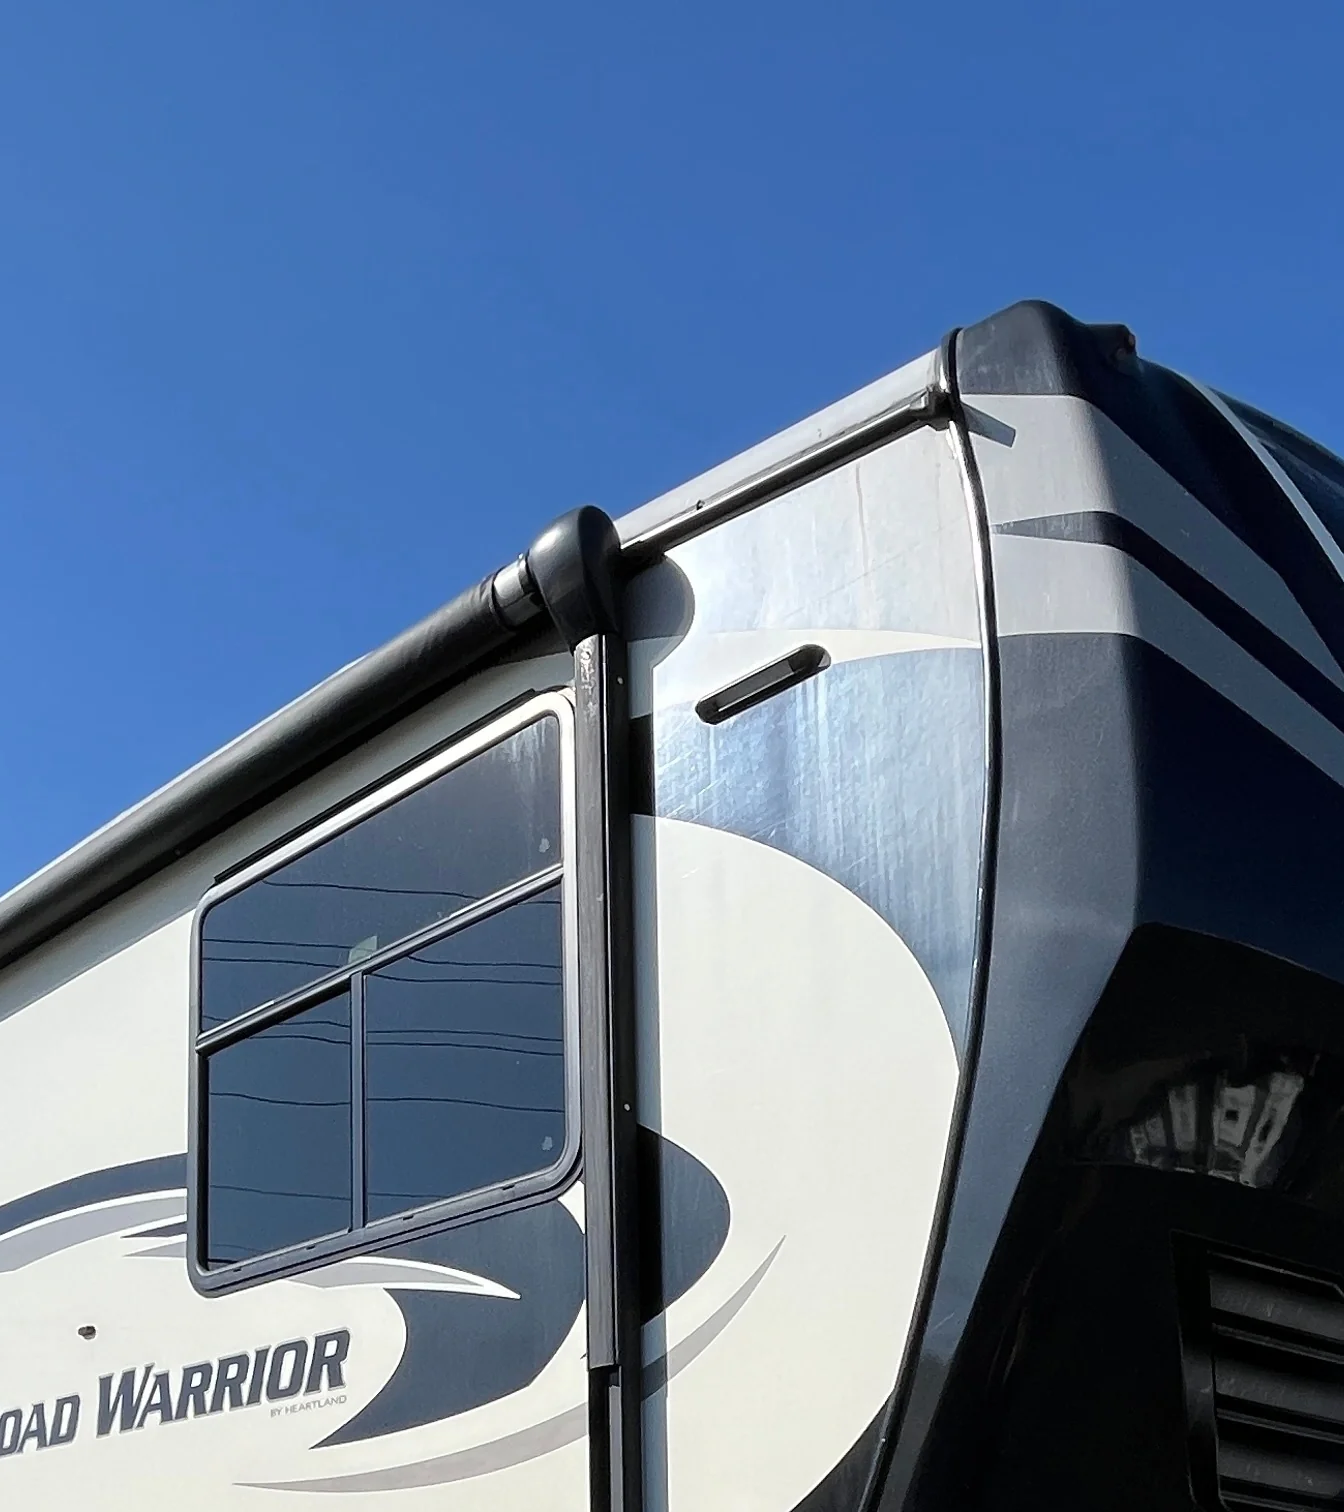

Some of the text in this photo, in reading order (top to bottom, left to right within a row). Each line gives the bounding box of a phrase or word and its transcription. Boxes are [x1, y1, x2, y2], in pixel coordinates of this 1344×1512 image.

[96, 1326, 351, 1440] WARRIOR
[270, 1395, 348, 1419] BY HEARTLAND
